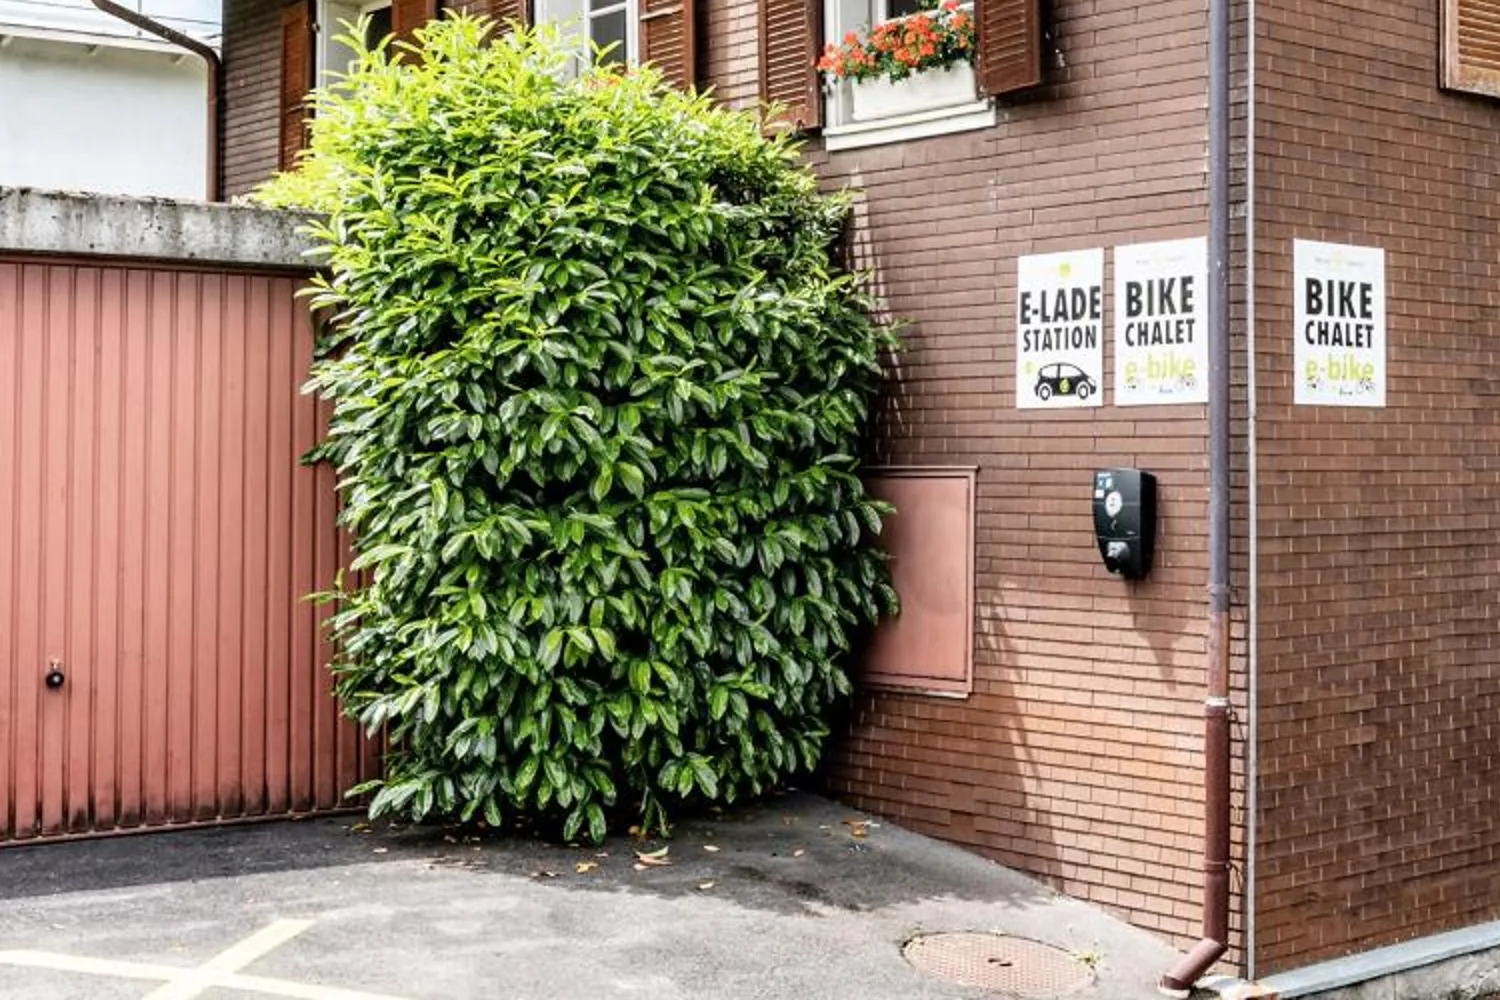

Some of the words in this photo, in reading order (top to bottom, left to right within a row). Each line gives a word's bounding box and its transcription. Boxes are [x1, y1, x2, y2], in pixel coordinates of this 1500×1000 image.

[1020, 286, 1101, 324] E-LADE
[1125, 276, 1194, 318] BIKE
[1305, 278, 1373, 320] BIKE
[1023, 325, 1097, 352] STATION
[1125, 318, 1195, 347] CHALET
[1305, 320, 1374, 348] CHALET
[1124, 352, 1196, 381] e-bike
[1305, 352, 1375, 381] e-bike
